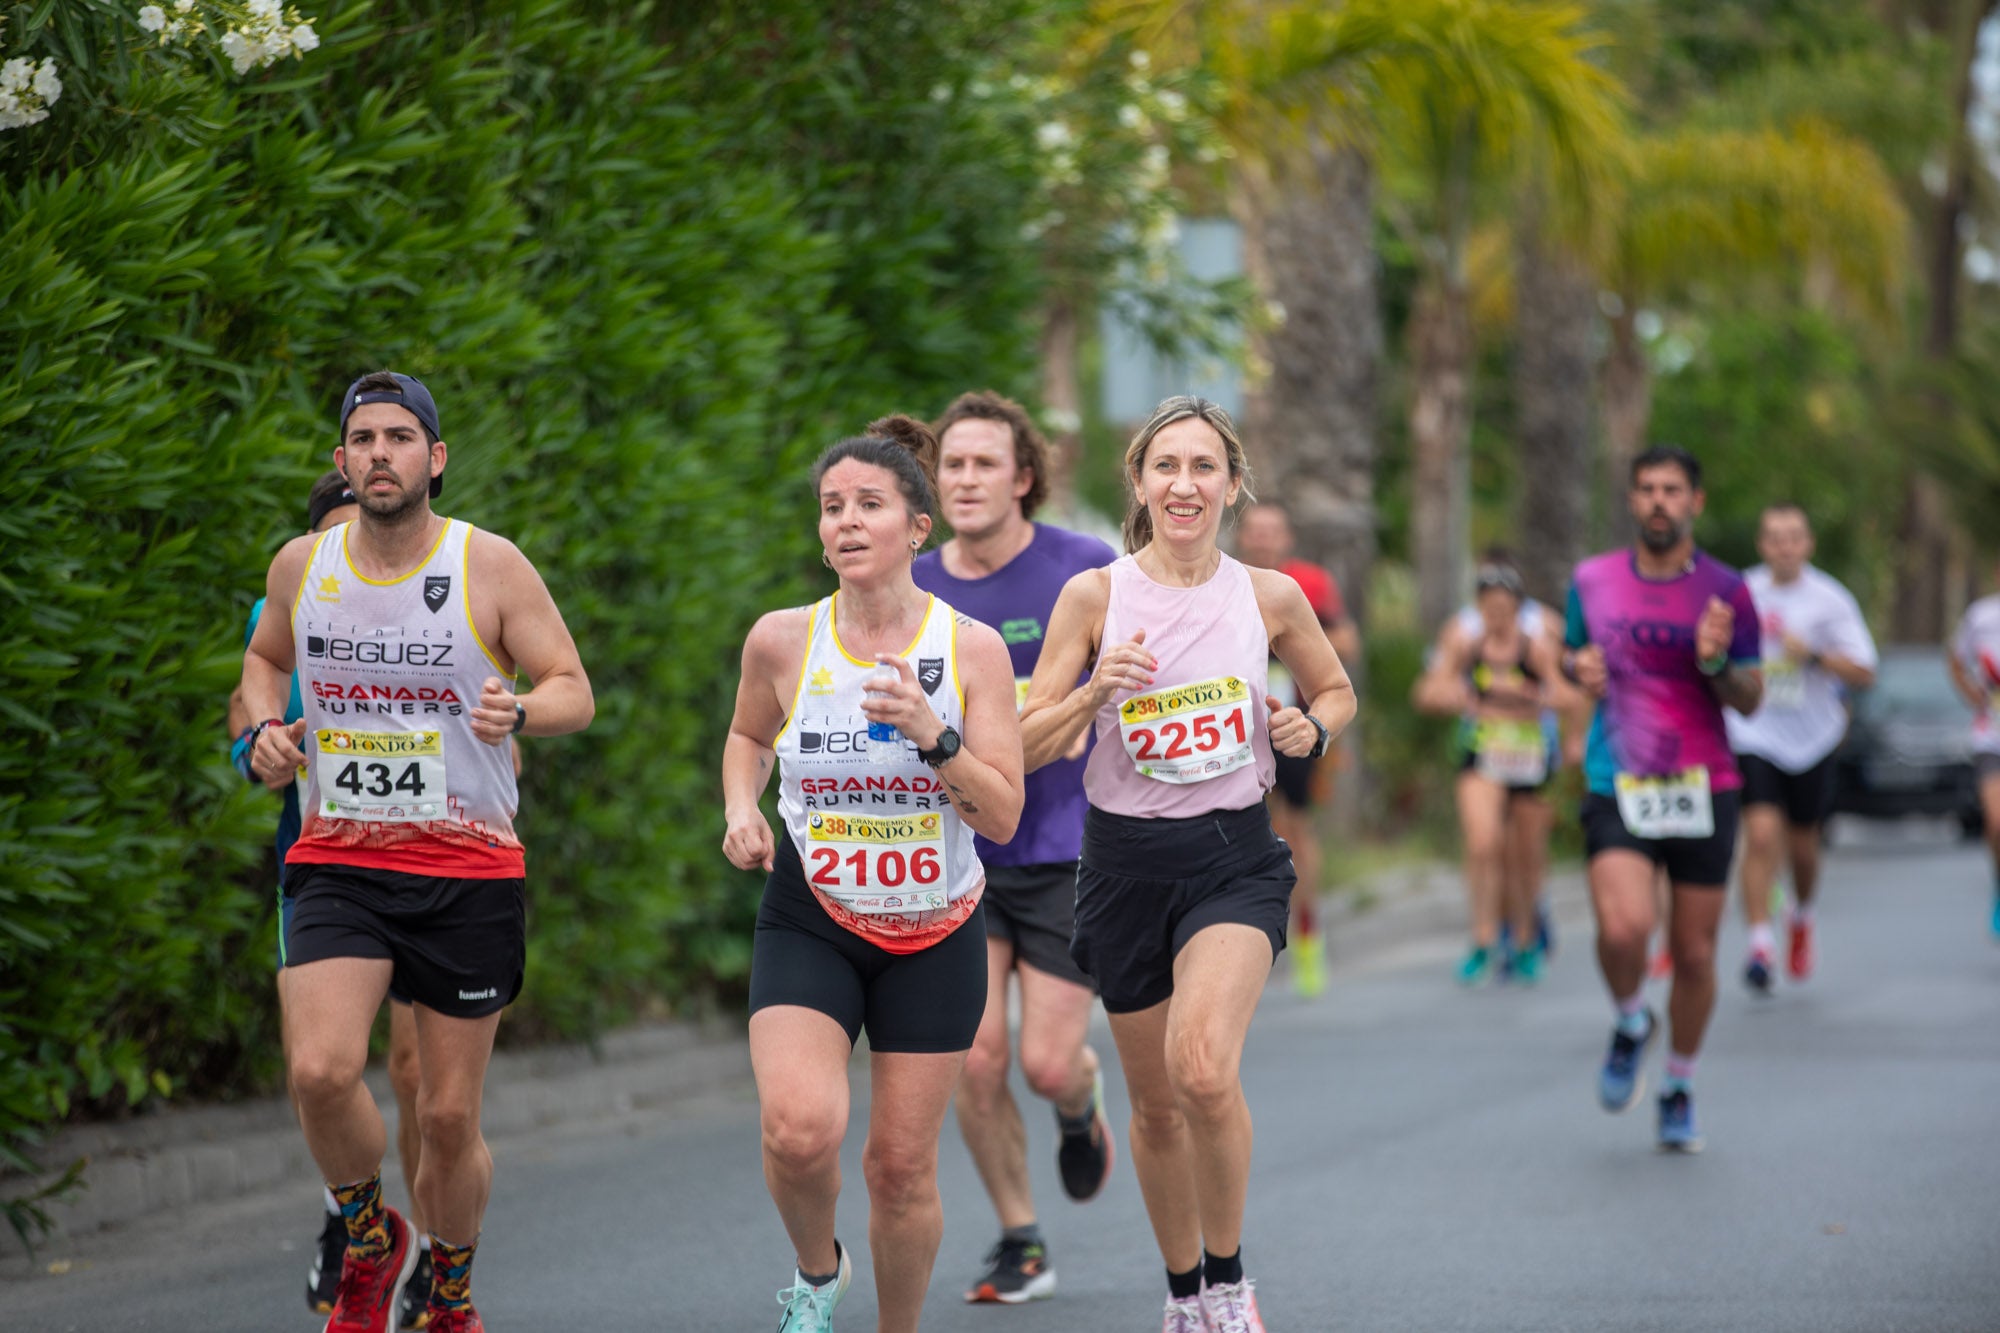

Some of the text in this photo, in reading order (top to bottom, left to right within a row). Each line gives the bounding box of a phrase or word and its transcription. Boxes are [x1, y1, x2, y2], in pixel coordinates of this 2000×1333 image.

[312, 680, 461, 703] GRANADA
[1159, 691, 1183, 700] GRAN
[1184, 682, 1215, 695] PREMIO
[318, 698, 462, 715] RUNNERS
[1136, 697, 1158, 716] 38
[354, 733, 377, 741] GRAN
[377, 734, 411, 742] PREMIO
[1128, 707, 1246, 761] 2251
[335, 761, 426, 797] 434
[805, 792, 951, 809] RUNNERS
[825, 817, 847, 836] 38
[850, 817, 873, 826] GRAN
[874, 818, 908, 827] PREMIO
[810, 846, 941, 887] 2106
